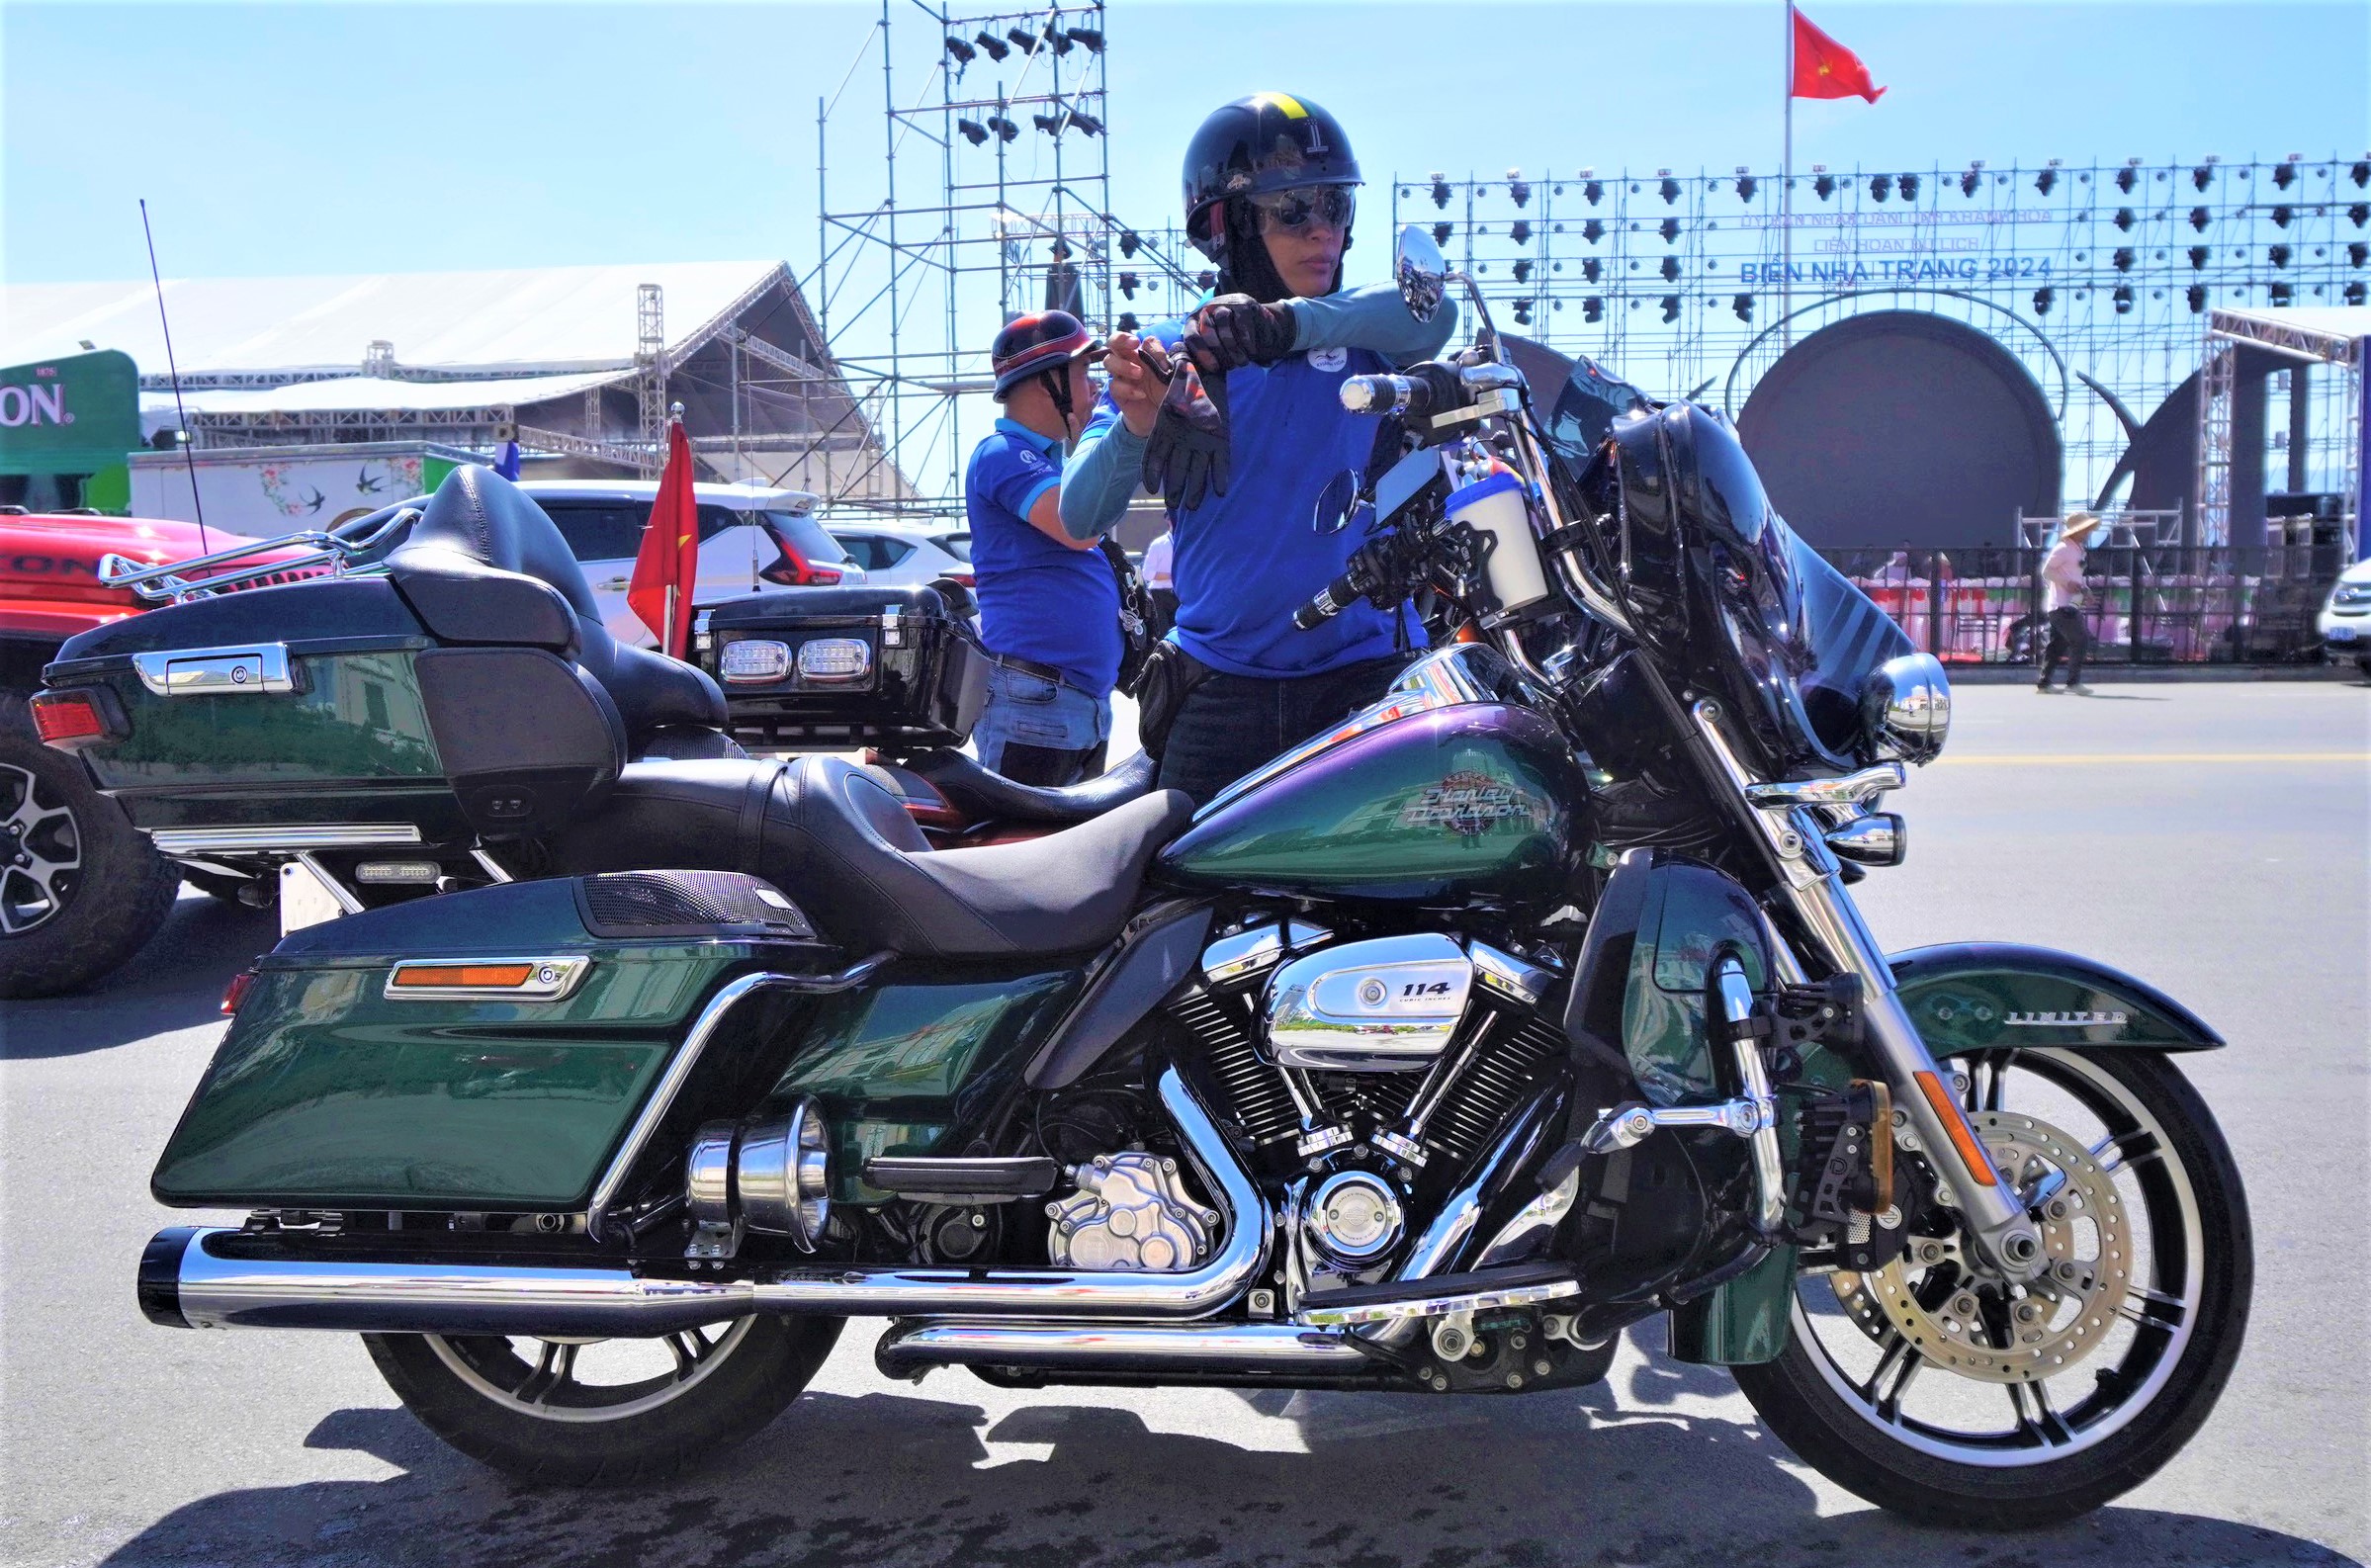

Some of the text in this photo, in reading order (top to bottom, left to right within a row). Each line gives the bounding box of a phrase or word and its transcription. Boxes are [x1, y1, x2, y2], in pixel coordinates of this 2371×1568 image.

[1741, 255, 2051, 283] BIỂN NHA TRANG 2024
[1403, 982, 1451, 996] 114
[2007, 1011, 2127, 1024] LIMITED
